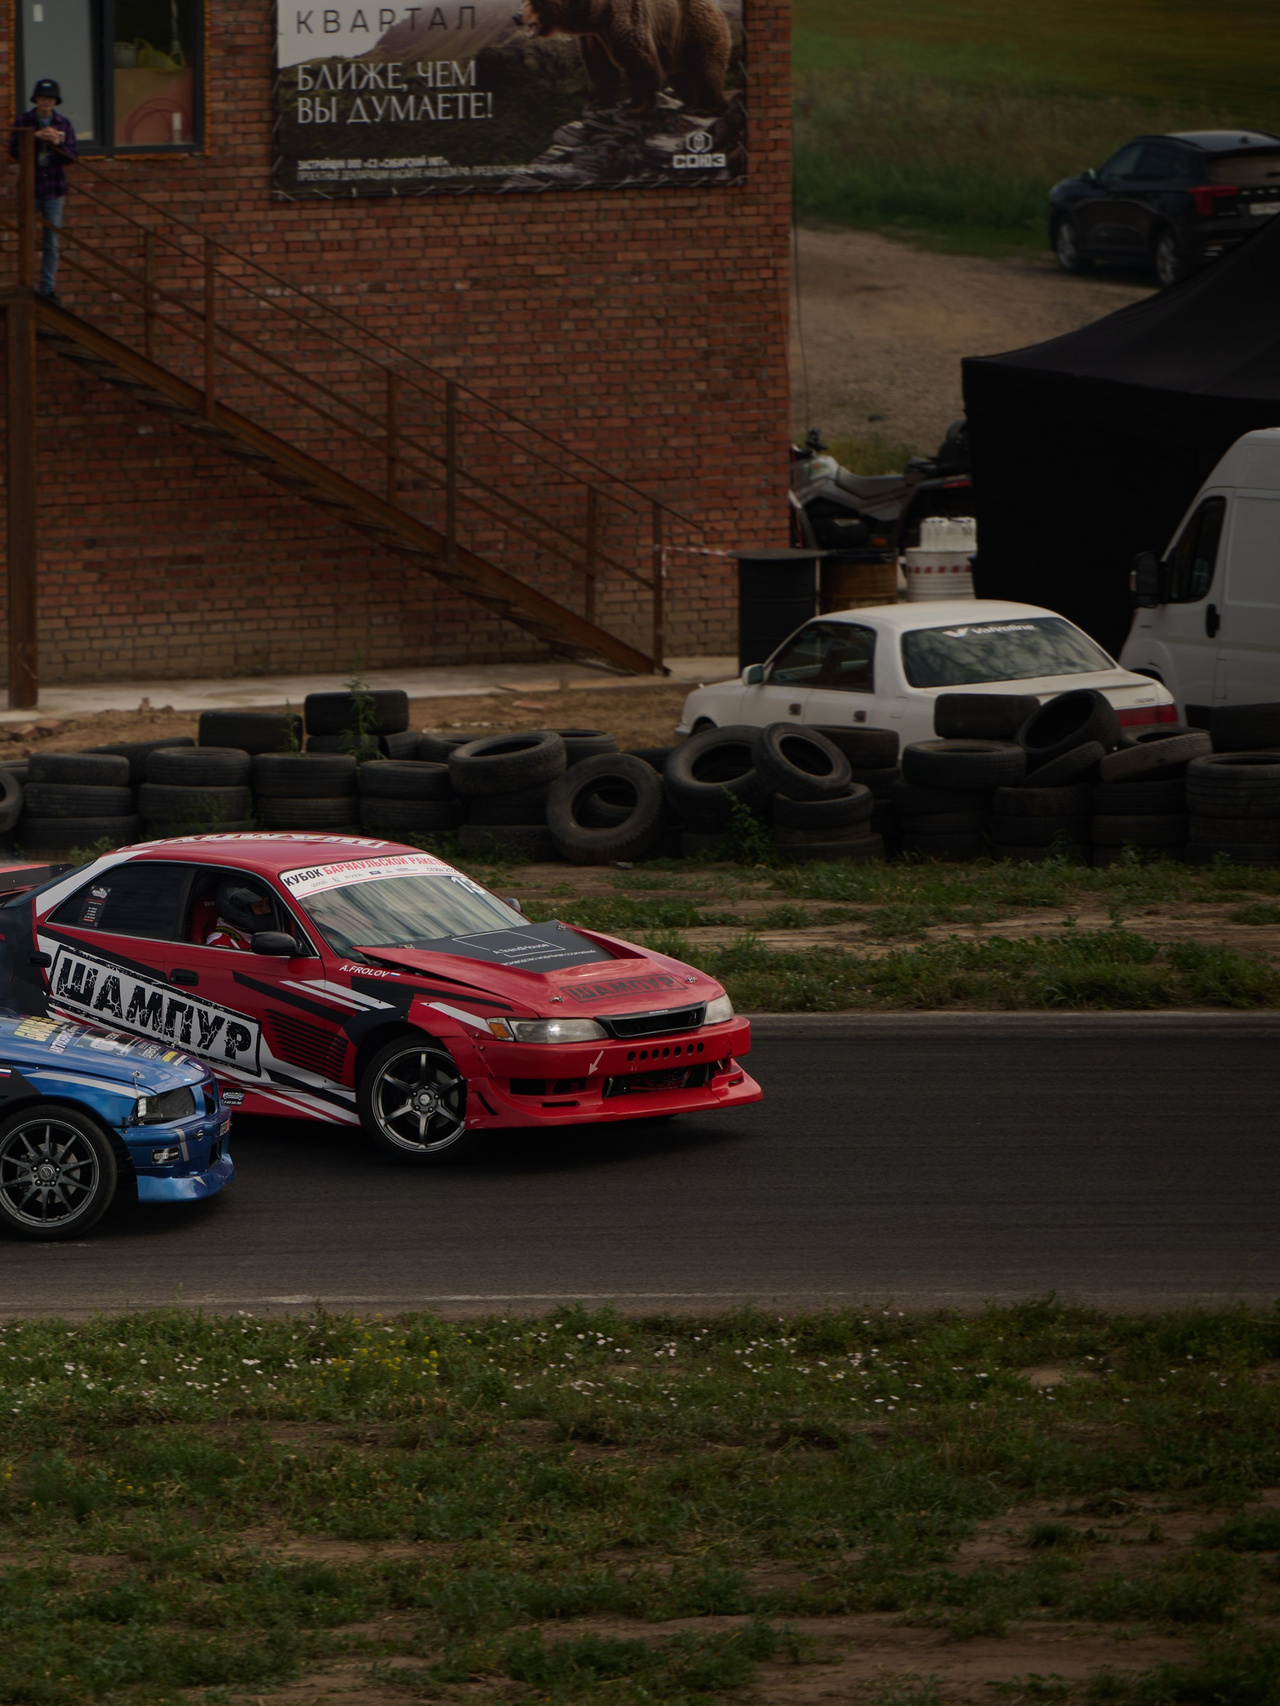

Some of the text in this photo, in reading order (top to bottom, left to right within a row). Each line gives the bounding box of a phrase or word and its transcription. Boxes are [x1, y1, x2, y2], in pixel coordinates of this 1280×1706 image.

[297, 7, 476, 34] КВАРТАЛ
[297, 60, 477, 92] БЛИЖЕ, ЧЕМ
[297, 92, 494, 125] ВЫ ДУМАЕТЕ!
[673, 153, 726, 169] СОЮЗ
[283, 868, 324, 887] КУБОК
[322, 855, 409, 875] БАРНАУЛЬСКОЙ
[451, 876, 485, 894] 13
[339, 964, 390, 978] A.FROLOV
[568, 976, 674, 999] ШАМПУР
[56, 957, 252, 1061] ШАМПУР
